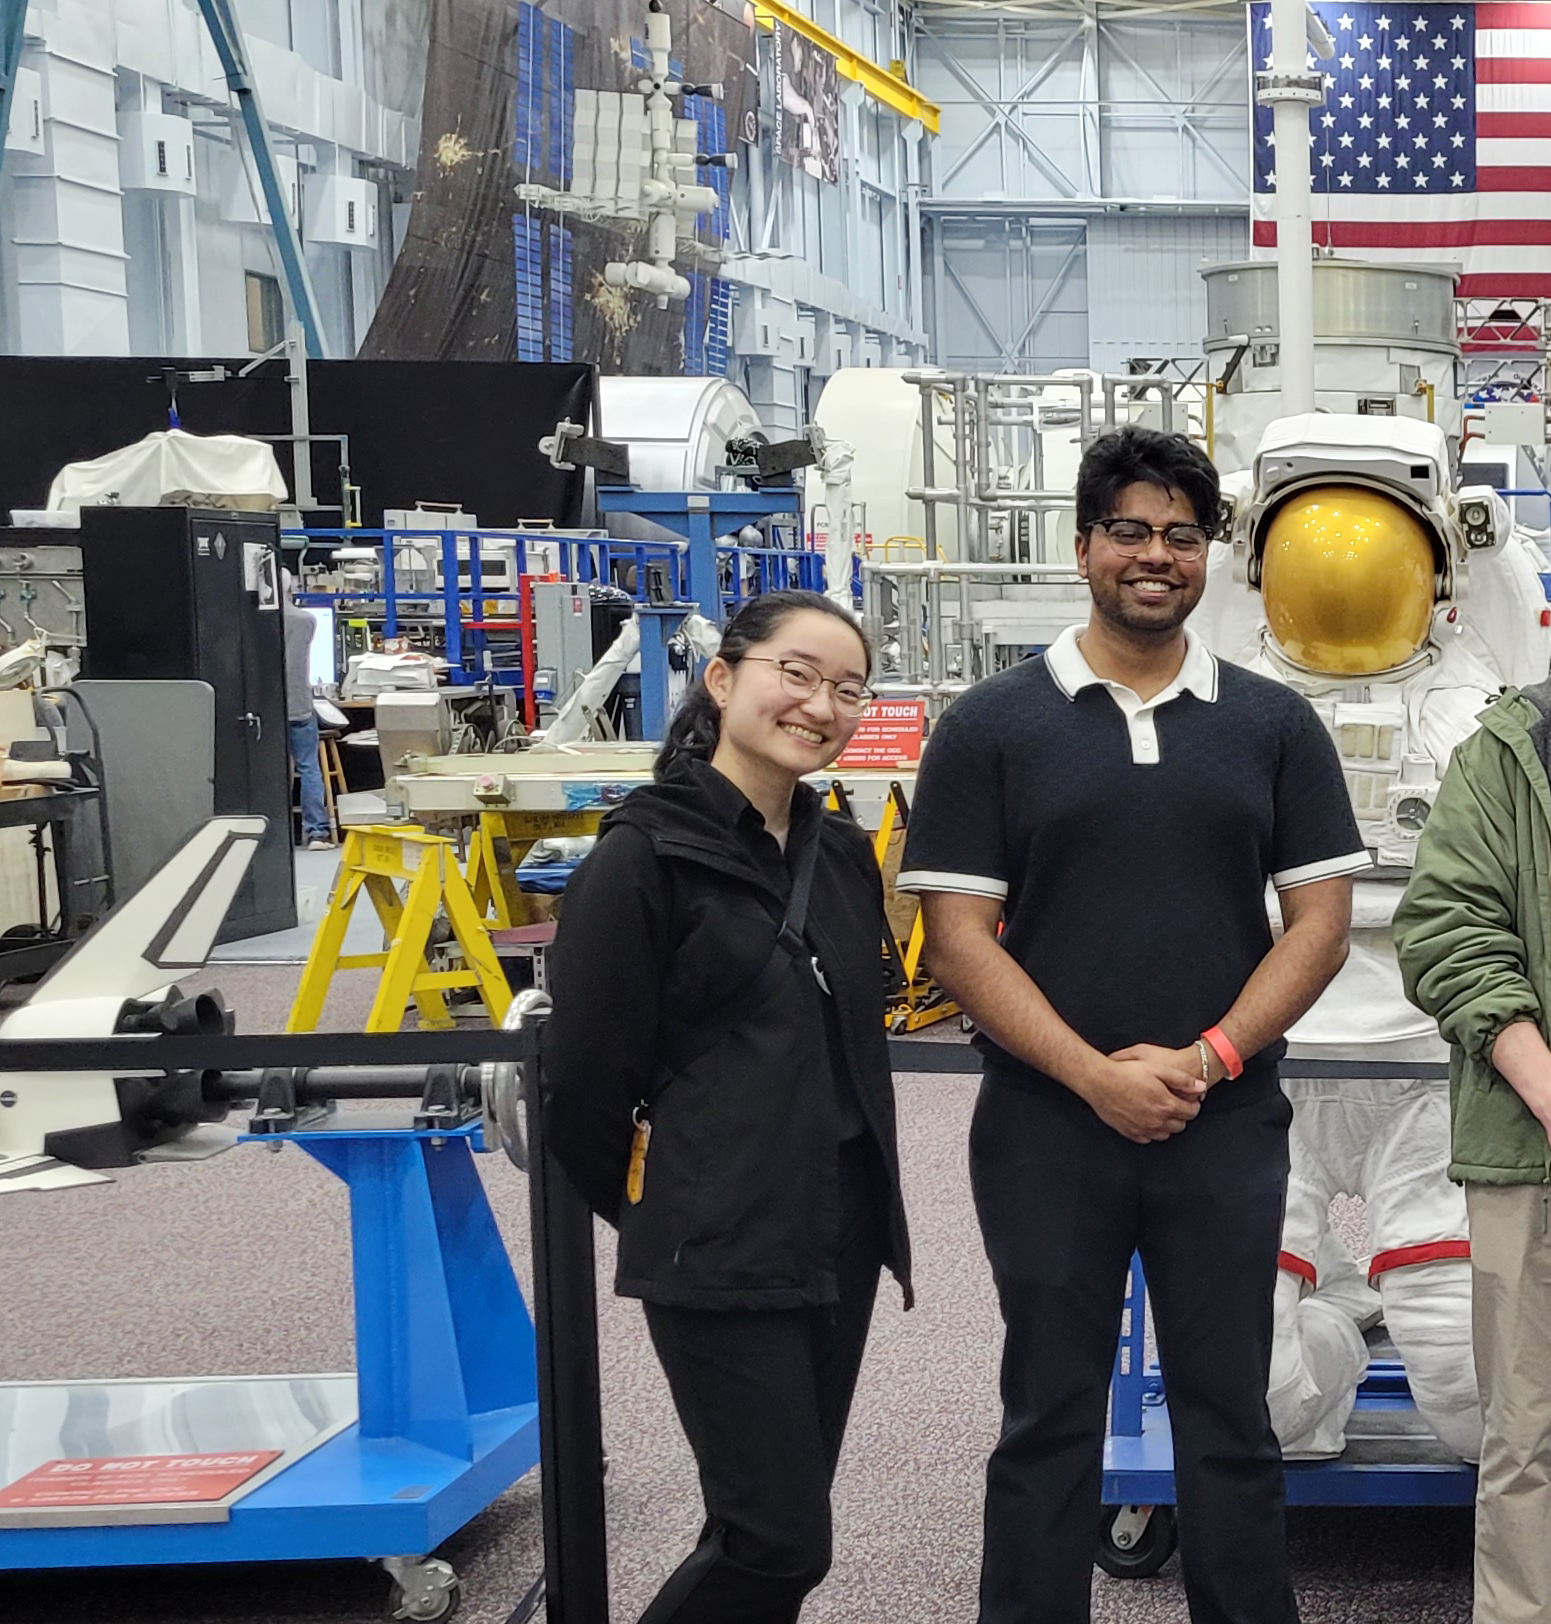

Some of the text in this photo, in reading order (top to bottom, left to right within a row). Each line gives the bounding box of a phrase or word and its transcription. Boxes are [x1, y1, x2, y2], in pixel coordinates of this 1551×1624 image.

[862, 706, 918, 717] OT TOUCH
[50, 1455, 260, 1473] DO NOT TOUCH
